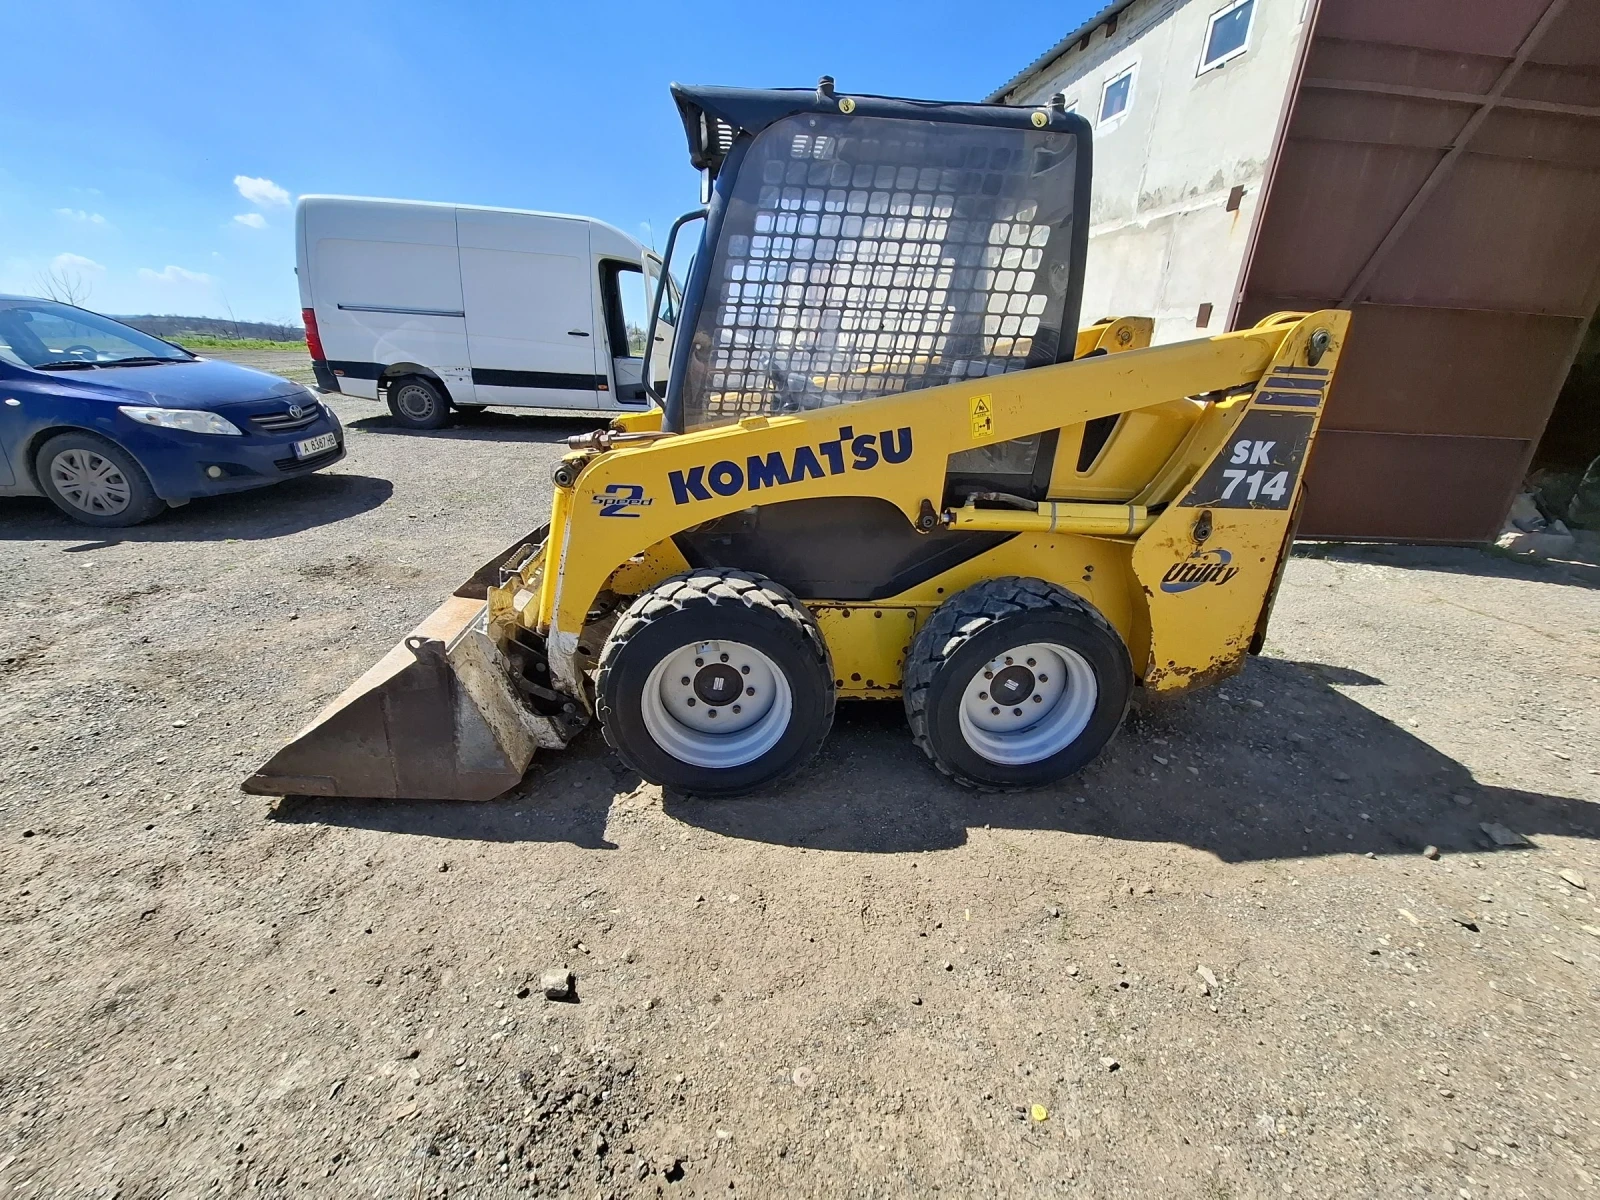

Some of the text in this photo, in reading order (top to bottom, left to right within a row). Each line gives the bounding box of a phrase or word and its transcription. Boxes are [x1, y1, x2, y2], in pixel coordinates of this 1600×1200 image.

[668, 426, 913, 505] KOMATSU
[1230, 440, 1276, 465] SK
[592, 484, 655, 518] 2 Speed
[1221, 469, 1289, 501] 714
[1162, 562, 1239, 586] Utility
